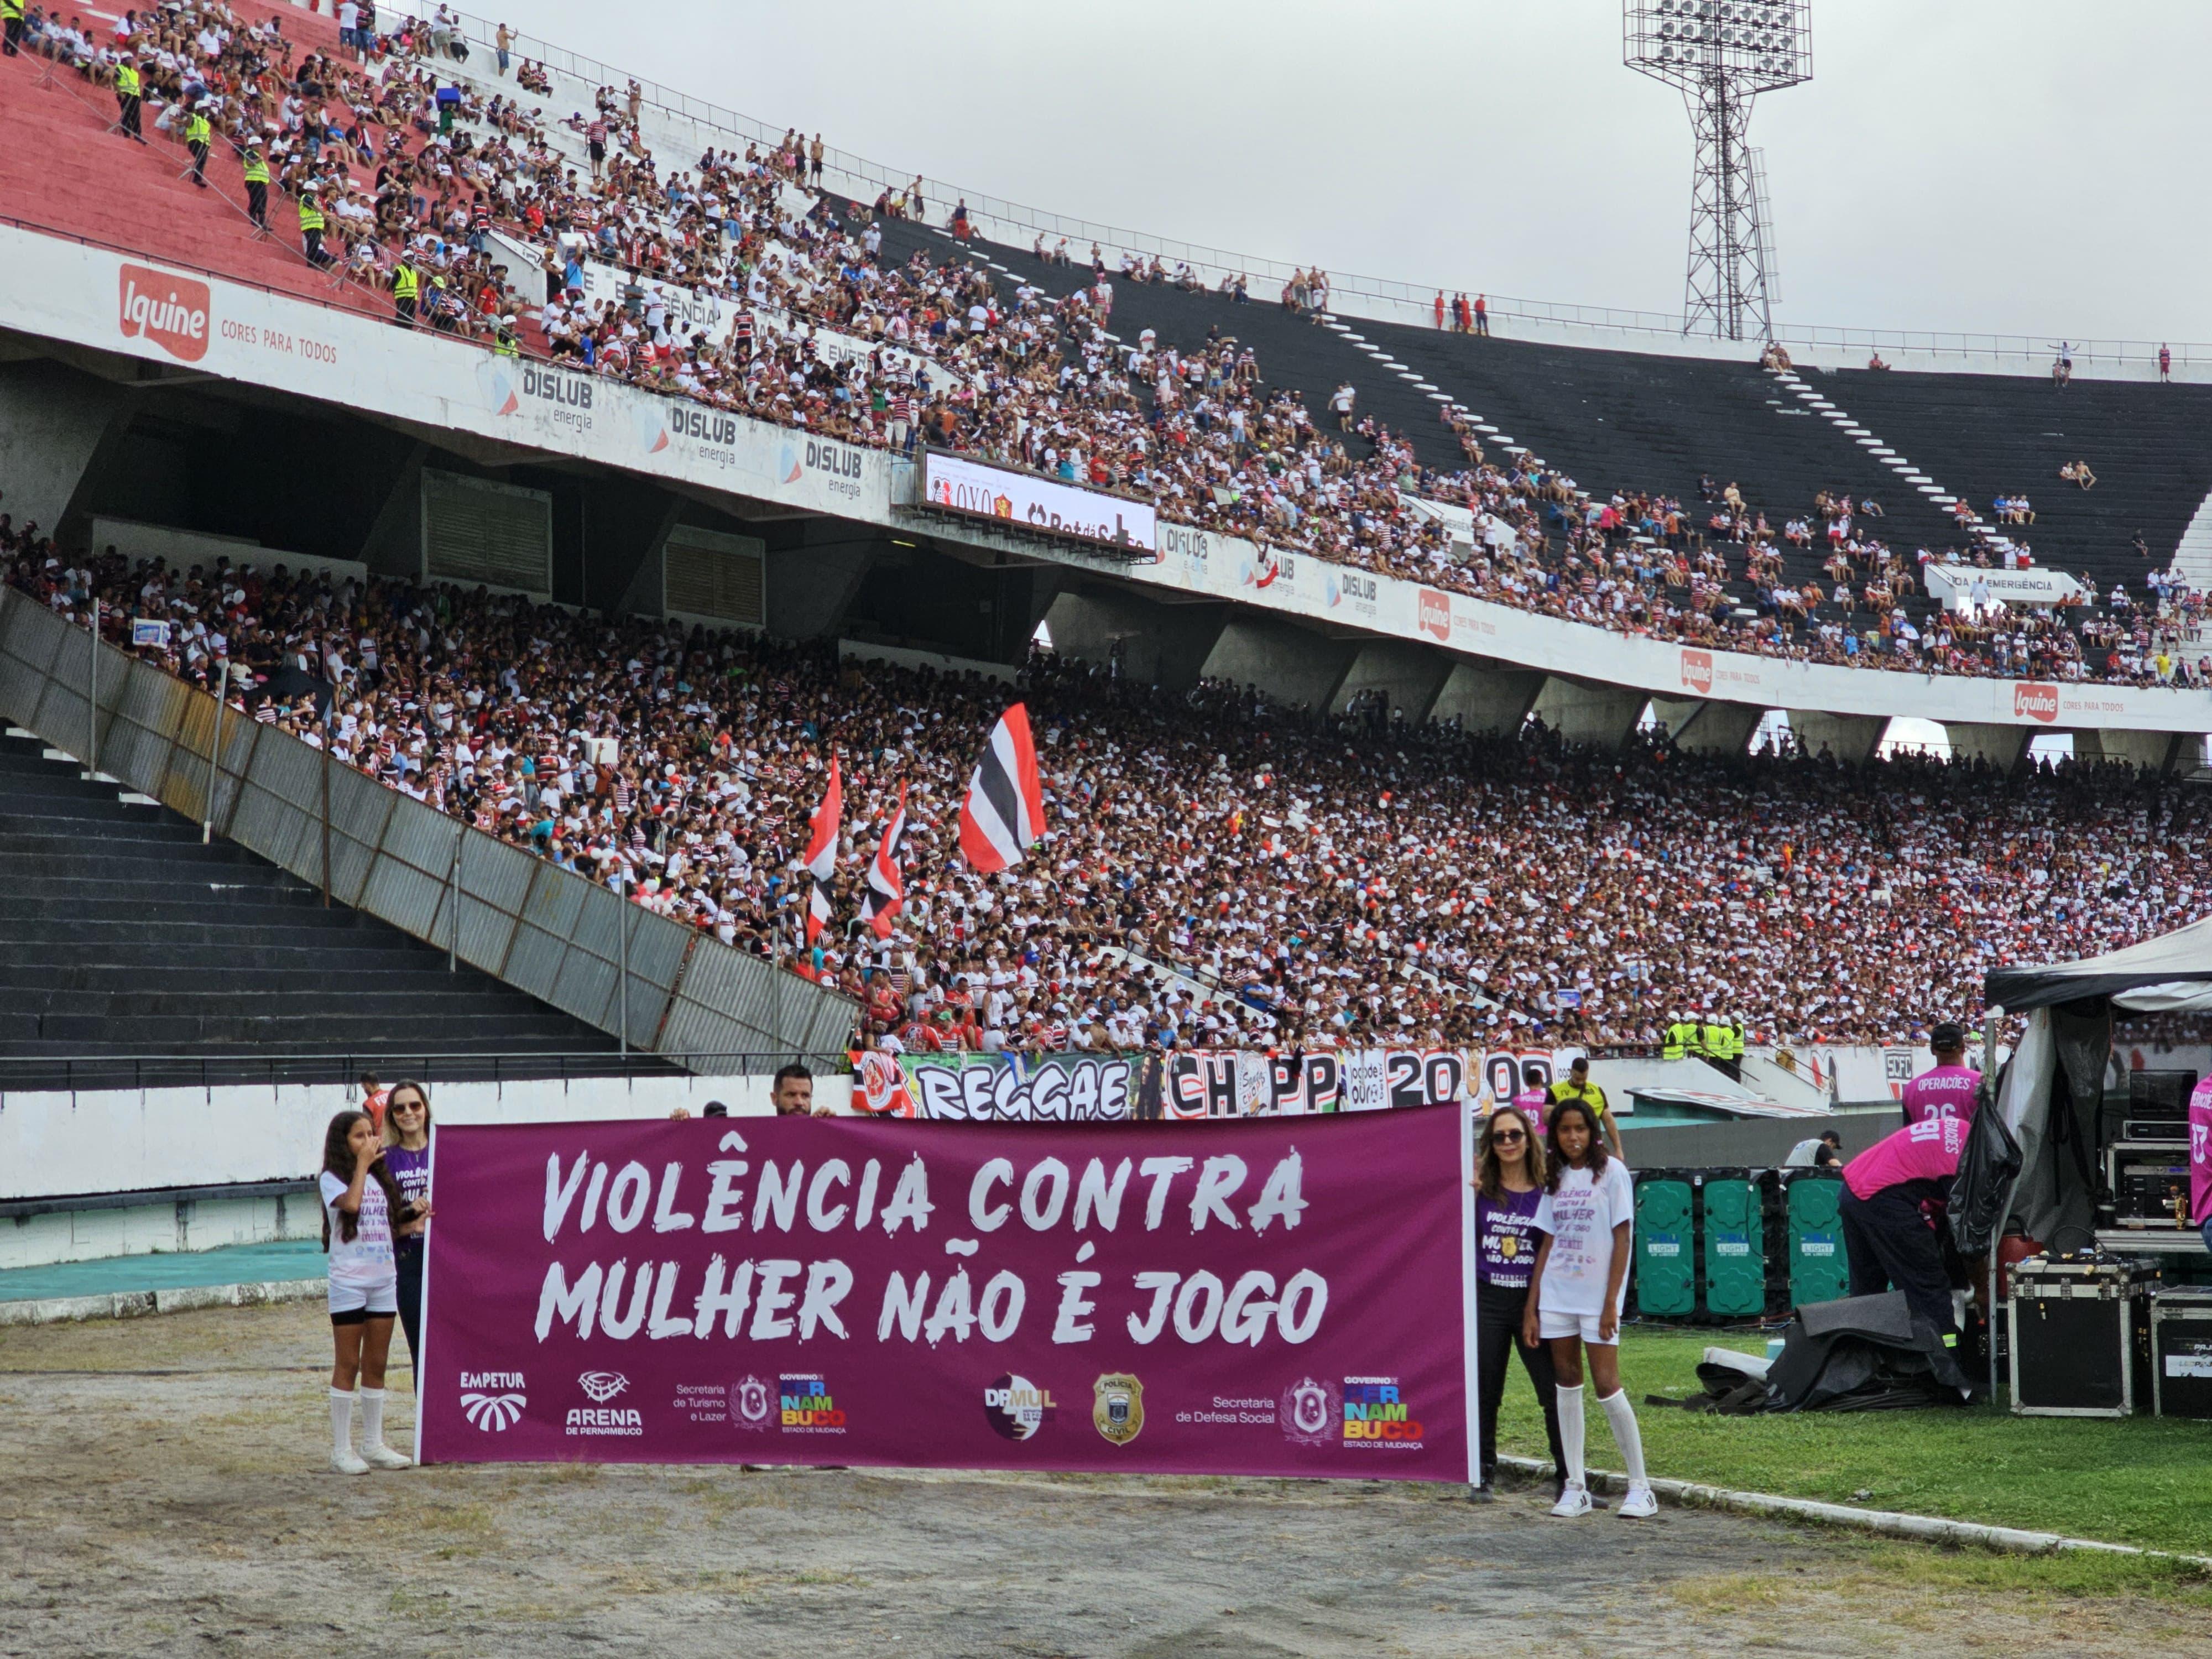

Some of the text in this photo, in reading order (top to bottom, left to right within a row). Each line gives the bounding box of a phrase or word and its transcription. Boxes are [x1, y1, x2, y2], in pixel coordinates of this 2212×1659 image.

[583, 271, 594, 292] E
[124, 279, 205, 339] Iquine
[221, 319, 337, 364] CORES PARA TODOS
[524, 368, 593, 409] DISLUB
[554, 408, 592, 433] energia
[672, 407, 735, 445] DISLUB
[699, 445, 735, 469] energia
[806, 441, 862, 479] DISLUB
[828, 478, 861, 500] energia
[1342, 573, 1377, 601] DISLUB
[1986, 578, 2053, 591] EMERGÊNCIA
[1420, 598, 1448, 630] Iquine
[1683, 657, 1712, 685] Iquine
[2016, 690, 2056, 715] Iquine
[2063, 701, 2124, 712] CORES PARA TODOS
[1887, 1056, 1912, 1078] SCFC
[917, 1062, 1129, 1120] REGGAE
[543, 1130, 1310, 1244] VIOLÊNCIA CONTRA
[1482, 1235, 1534, 1251] MUER
[534, 1238, 1328, 1349] MULHER NÃO É JOGO
[460, 1371, 526, 1389] EMPETUR
[1104, 1379, 1133, 1390] POLÍCIA
[676, 1385, 725, 1395] Secretaria
[985, 1389, 1057, 1408] DPMUL
[1344, 1386, 1400, 1404] PER
[673, 1398, 726, 1408] de Turismo
[781, 1396, 832, 1411] NAM
[1213, 1396, 1275, 1408] Secretaria
[566, 1408, 642, 1426] ARENA
[691, 1413, 726, 1422] e Lazer
[781, 1410, 846, 1426] BUCO
[1176, 1412, 1275, 1424] de Defesa Social
[1344, 1403, 1407, 1421] NAM
[580, 1427, 643, 1436] PERNAMBUCO
[1107, 1426, 1130, 1435] CIVIL
[1343, 1421, 1423, 1439] BUCO
[1385, 1442, 1423, 1450] MUDANÇA
